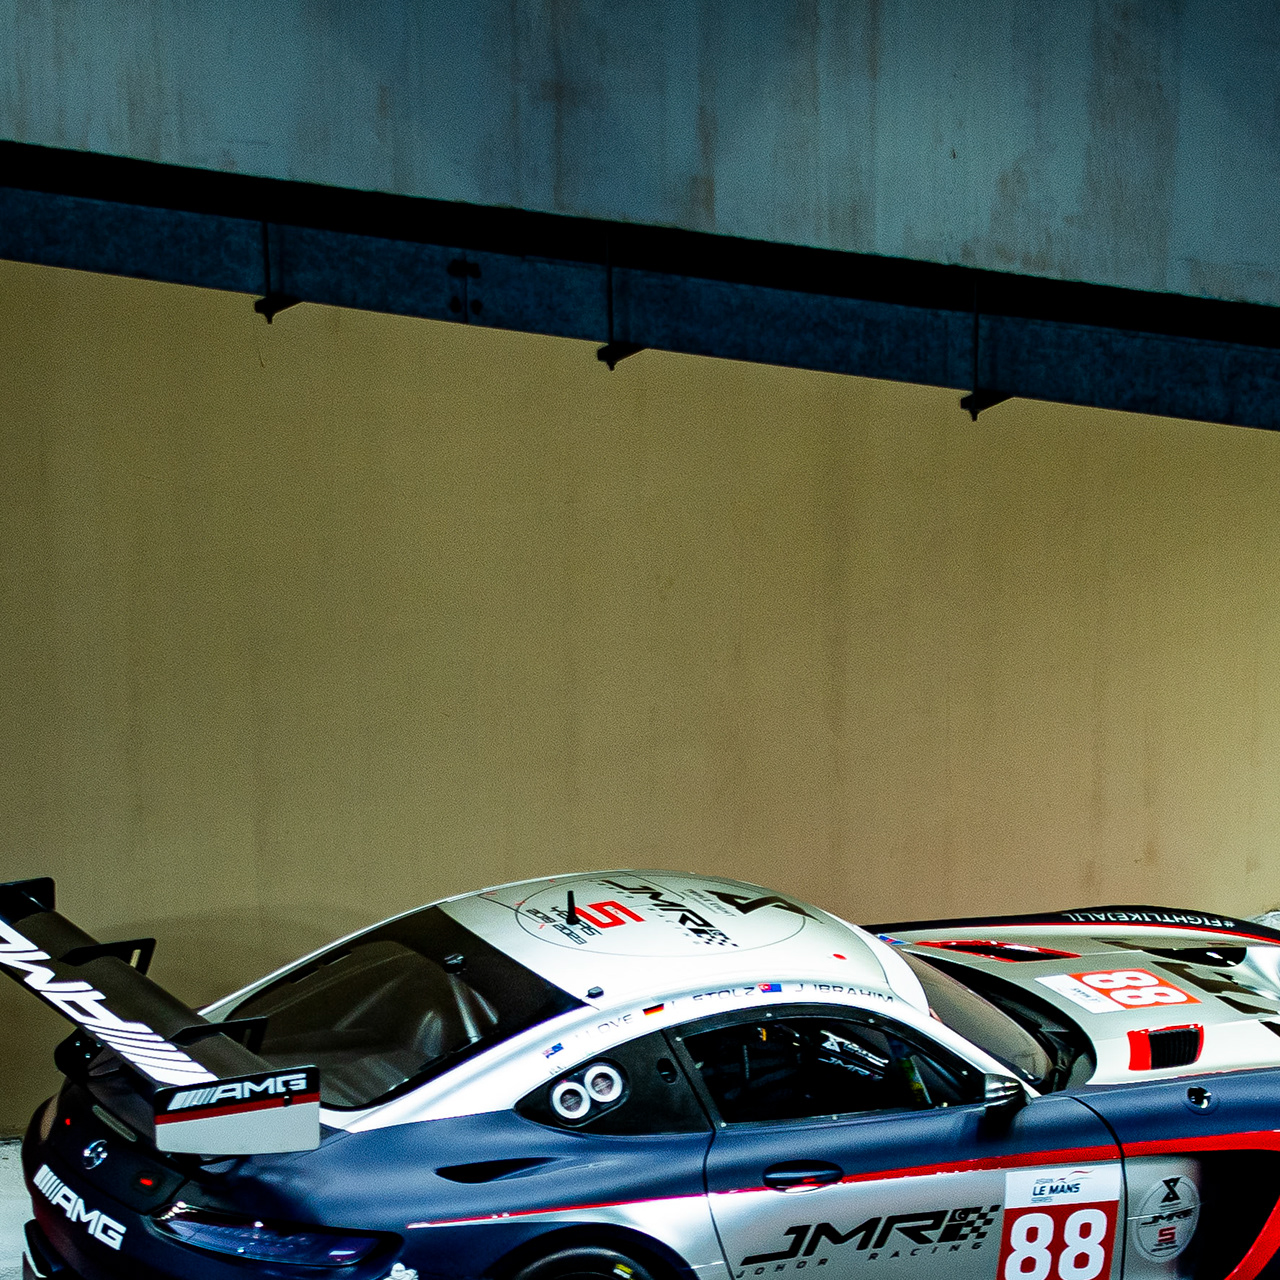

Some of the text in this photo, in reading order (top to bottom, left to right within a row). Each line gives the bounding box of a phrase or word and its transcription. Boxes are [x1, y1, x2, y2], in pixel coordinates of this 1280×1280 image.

[1062, 912, 1236, 929] #FIGHTLIKEJALIL
[813, 984, 894, 1003] IBRAHIM
[1081, 970, 1188, 1006] 88
[213, 1072, 308, 1101] AMG
[1032, 1182, 1081, 1196] LE MANS
[51, 1187, 128, 1251] AMG
[739, 1209, 950, 1267] JMR
[736, 1241, 984, 1279] JOHOR RACING
